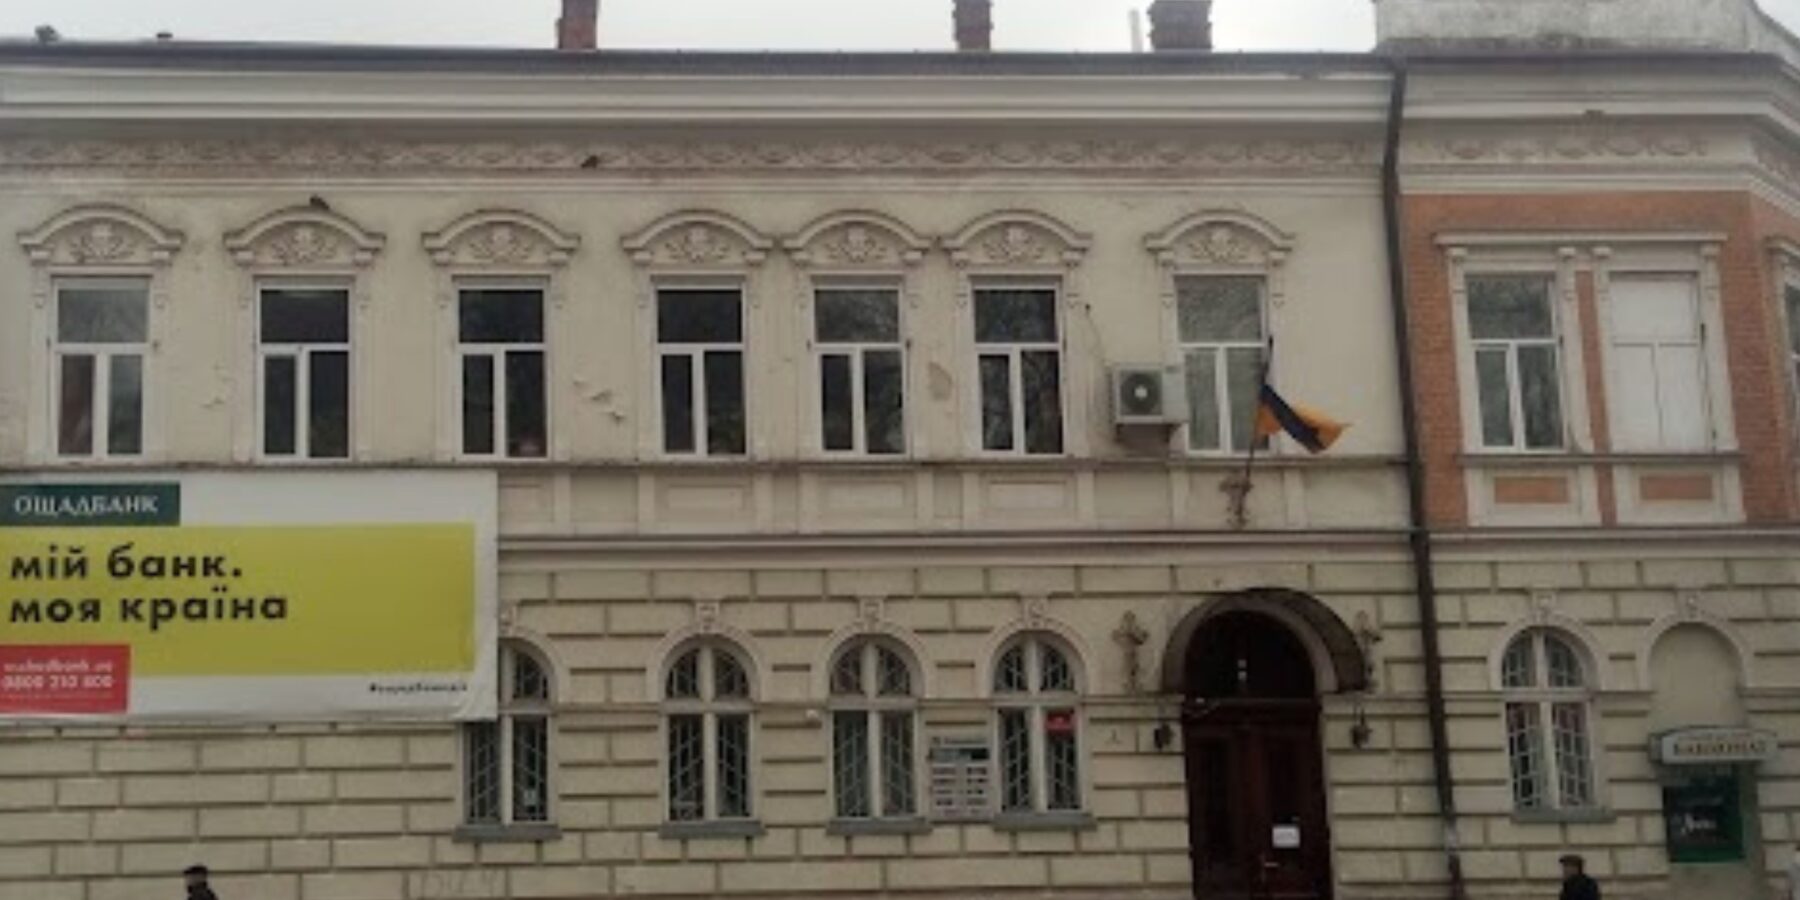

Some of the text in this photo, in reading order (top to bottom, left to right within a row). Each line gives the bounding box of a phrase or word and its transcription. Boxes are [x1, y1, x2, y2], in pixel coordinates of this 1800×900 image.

[14, 494, 160, 517] ОЩАДБАНК
[10, 541, 243, 580] мій банк.
[9, 585, 289, 631] моя країна
